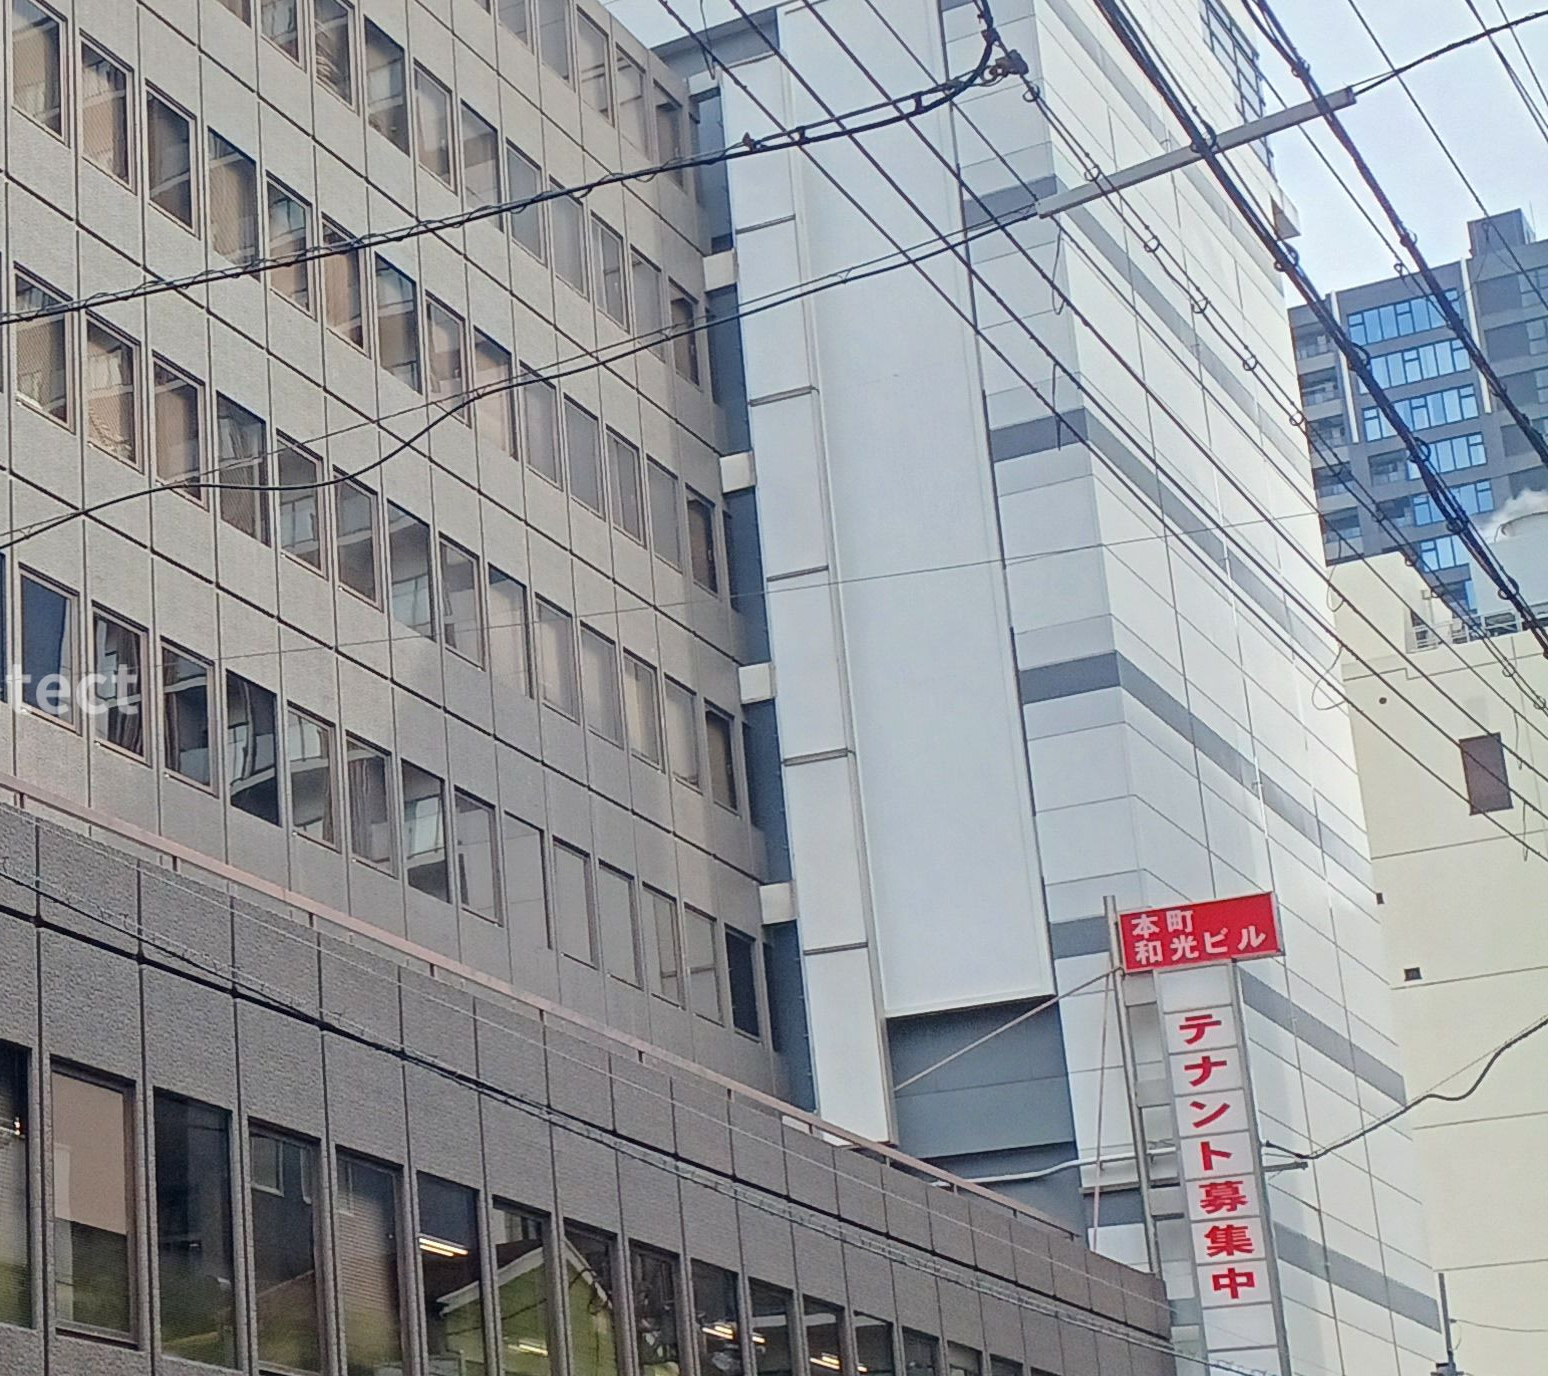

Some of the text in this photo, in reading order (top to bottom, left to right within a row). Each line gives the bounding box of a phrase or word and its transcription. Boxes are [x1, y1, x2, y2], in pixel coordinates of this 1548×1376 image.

[1131, 910, 1194, 939] 本町
[1134, 925, 1266, 965] 和光ビル
[1179, 1013, 1256, 1300] テナント募集中
